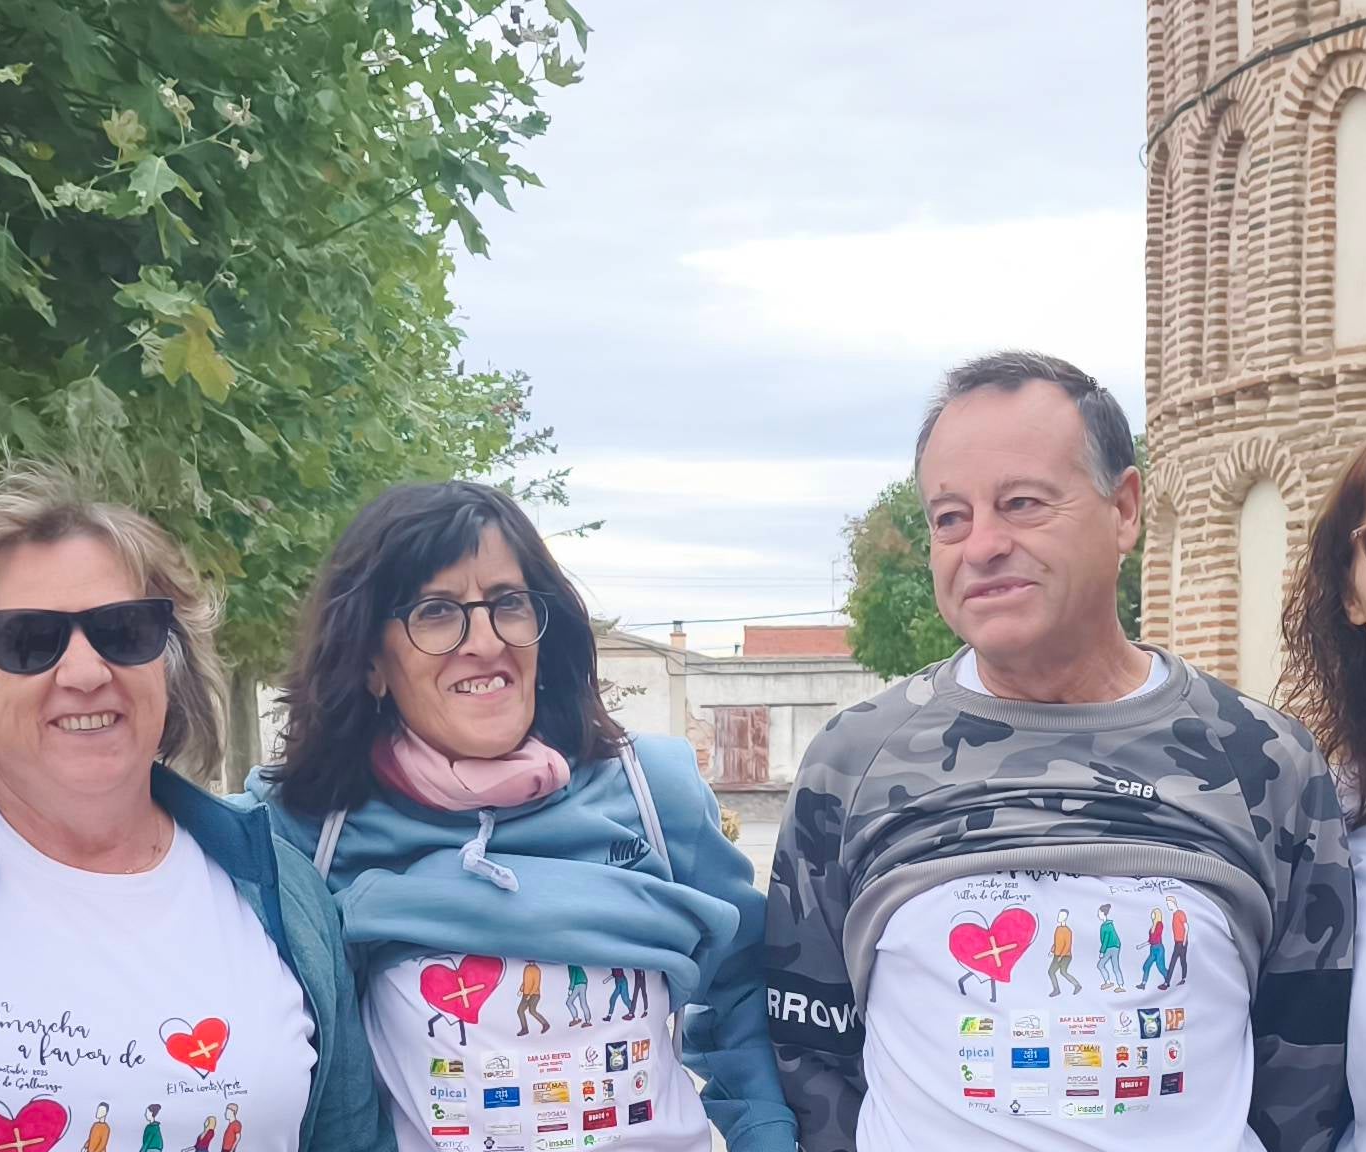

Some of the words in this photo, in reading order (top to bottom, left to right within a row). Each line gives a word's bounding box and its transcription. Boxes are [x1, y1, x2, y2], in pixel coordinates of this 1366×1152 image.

[0, 1010, 90, 1039] marcha
[18, 1044, 32, 1060] a
[39, 1033, 111, 1067] favor
[119, 1039, 146, 1068] de
